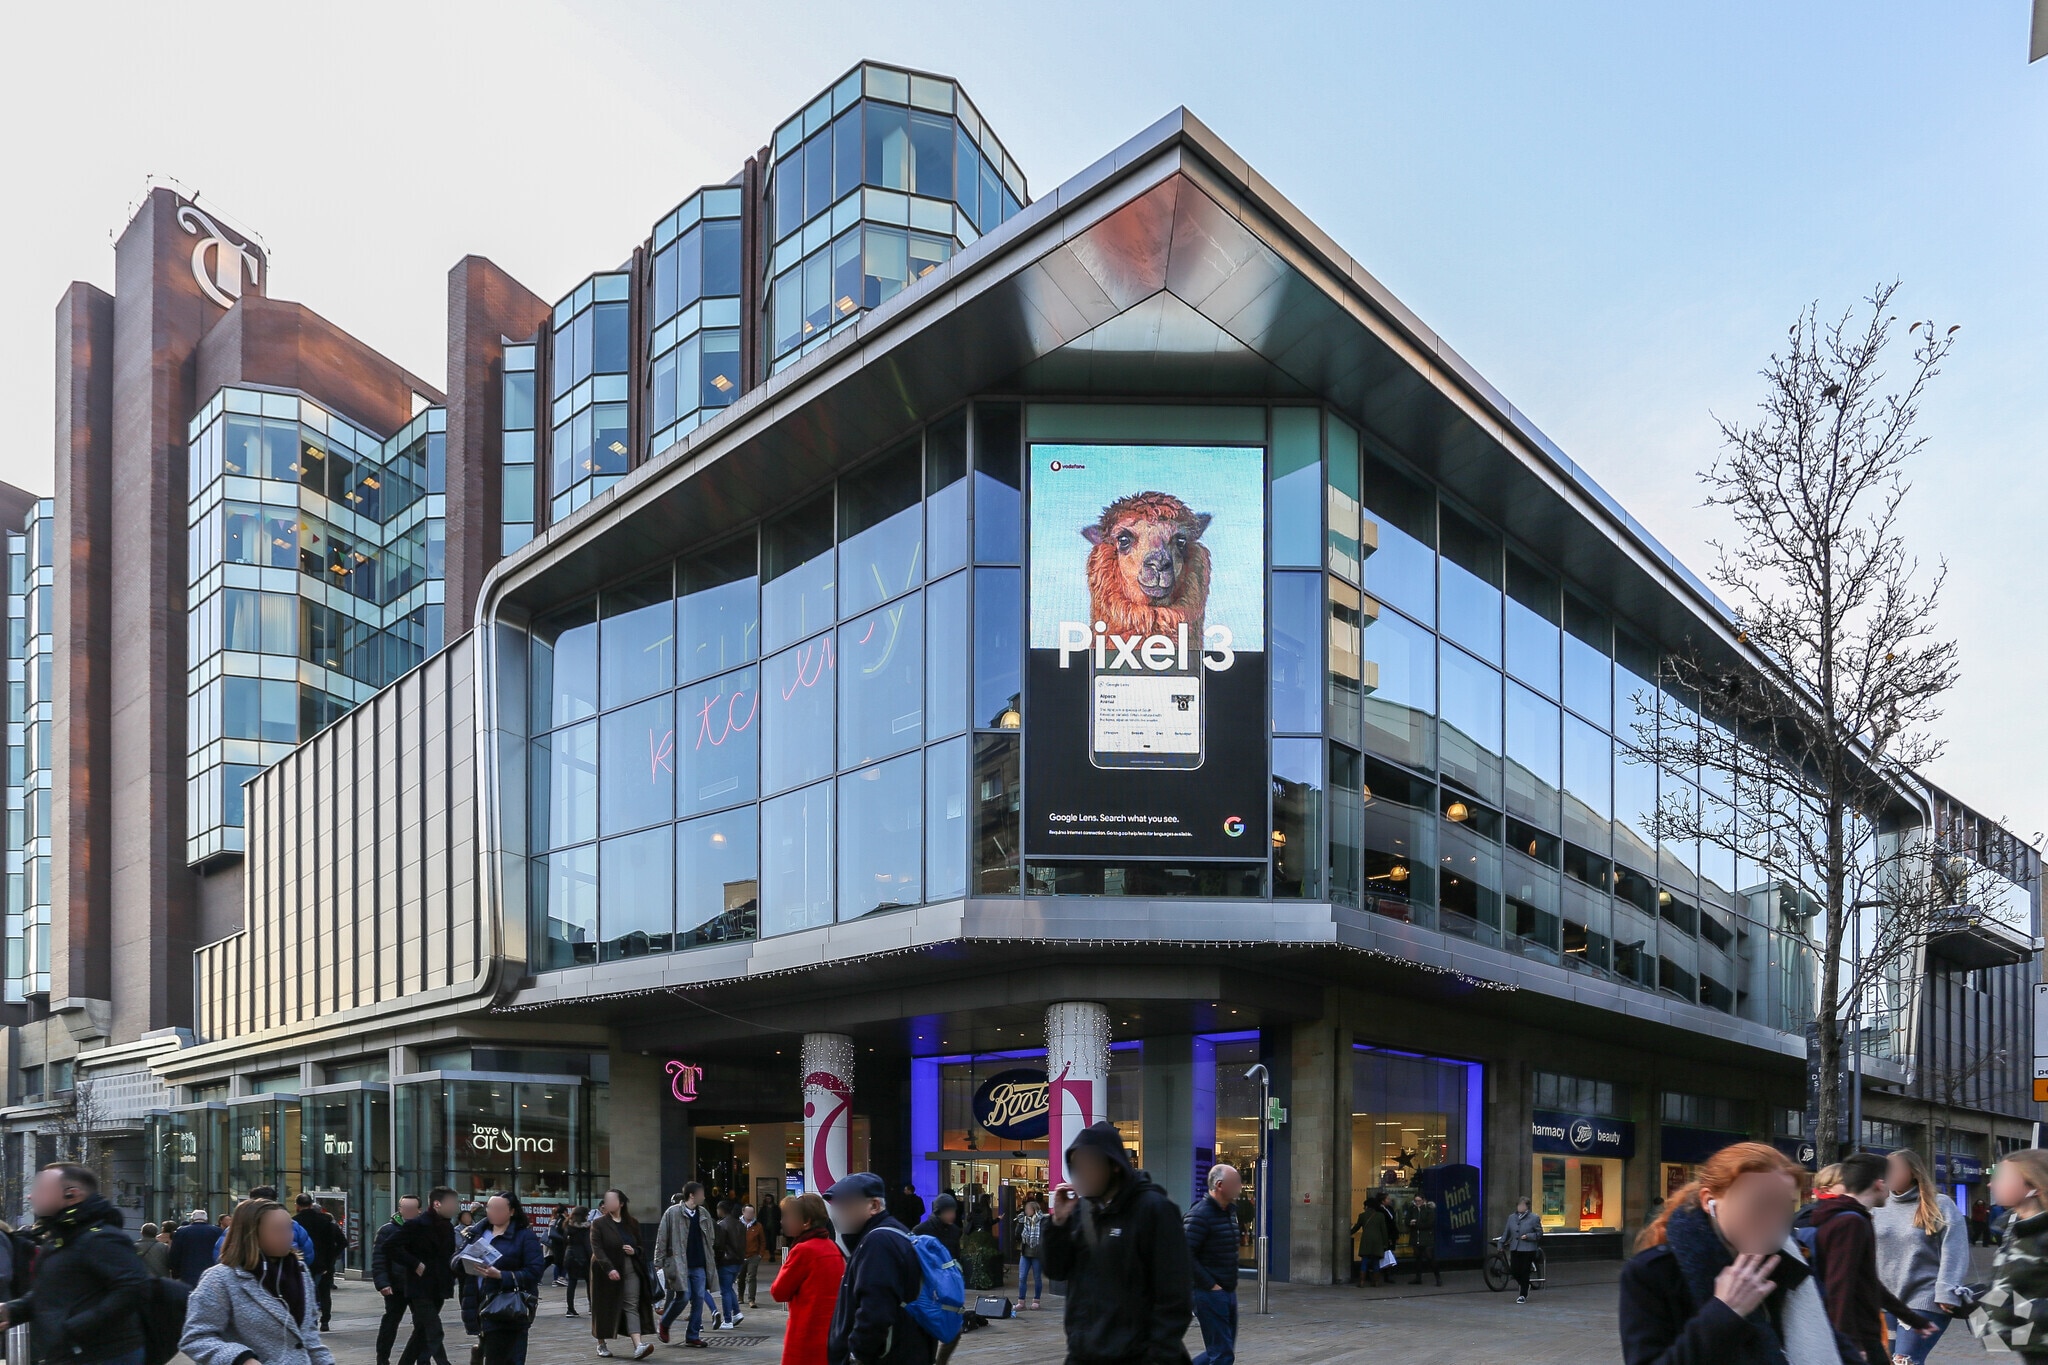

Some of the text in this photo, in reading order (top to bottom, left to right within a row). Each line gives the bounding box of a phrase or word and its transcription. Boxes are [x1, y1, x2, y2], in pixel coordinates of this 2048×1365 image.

[1058, 620, 1237, 673] Pixel 3
[1049, 812, 1078, 824] Google
[1079, 813, 1099, 823] Lens.
[1100, 813, 1127, 823] Search
[1127, 814, 1147, 823] what
[1148, 816, 1163, 825] you
[472, 1123, 499, 1135] love
[472, 1128, 554, 1153] aroma
[1532, 1122, 1565, 1140] harmacy
[1597, 1129, 1621, 1145] beauty
[1444, 1181, 1472, 1210] hint
[533, 1206, 553, 1215] CLOSIN
[1450, 1204, 1476, 1229] hint
